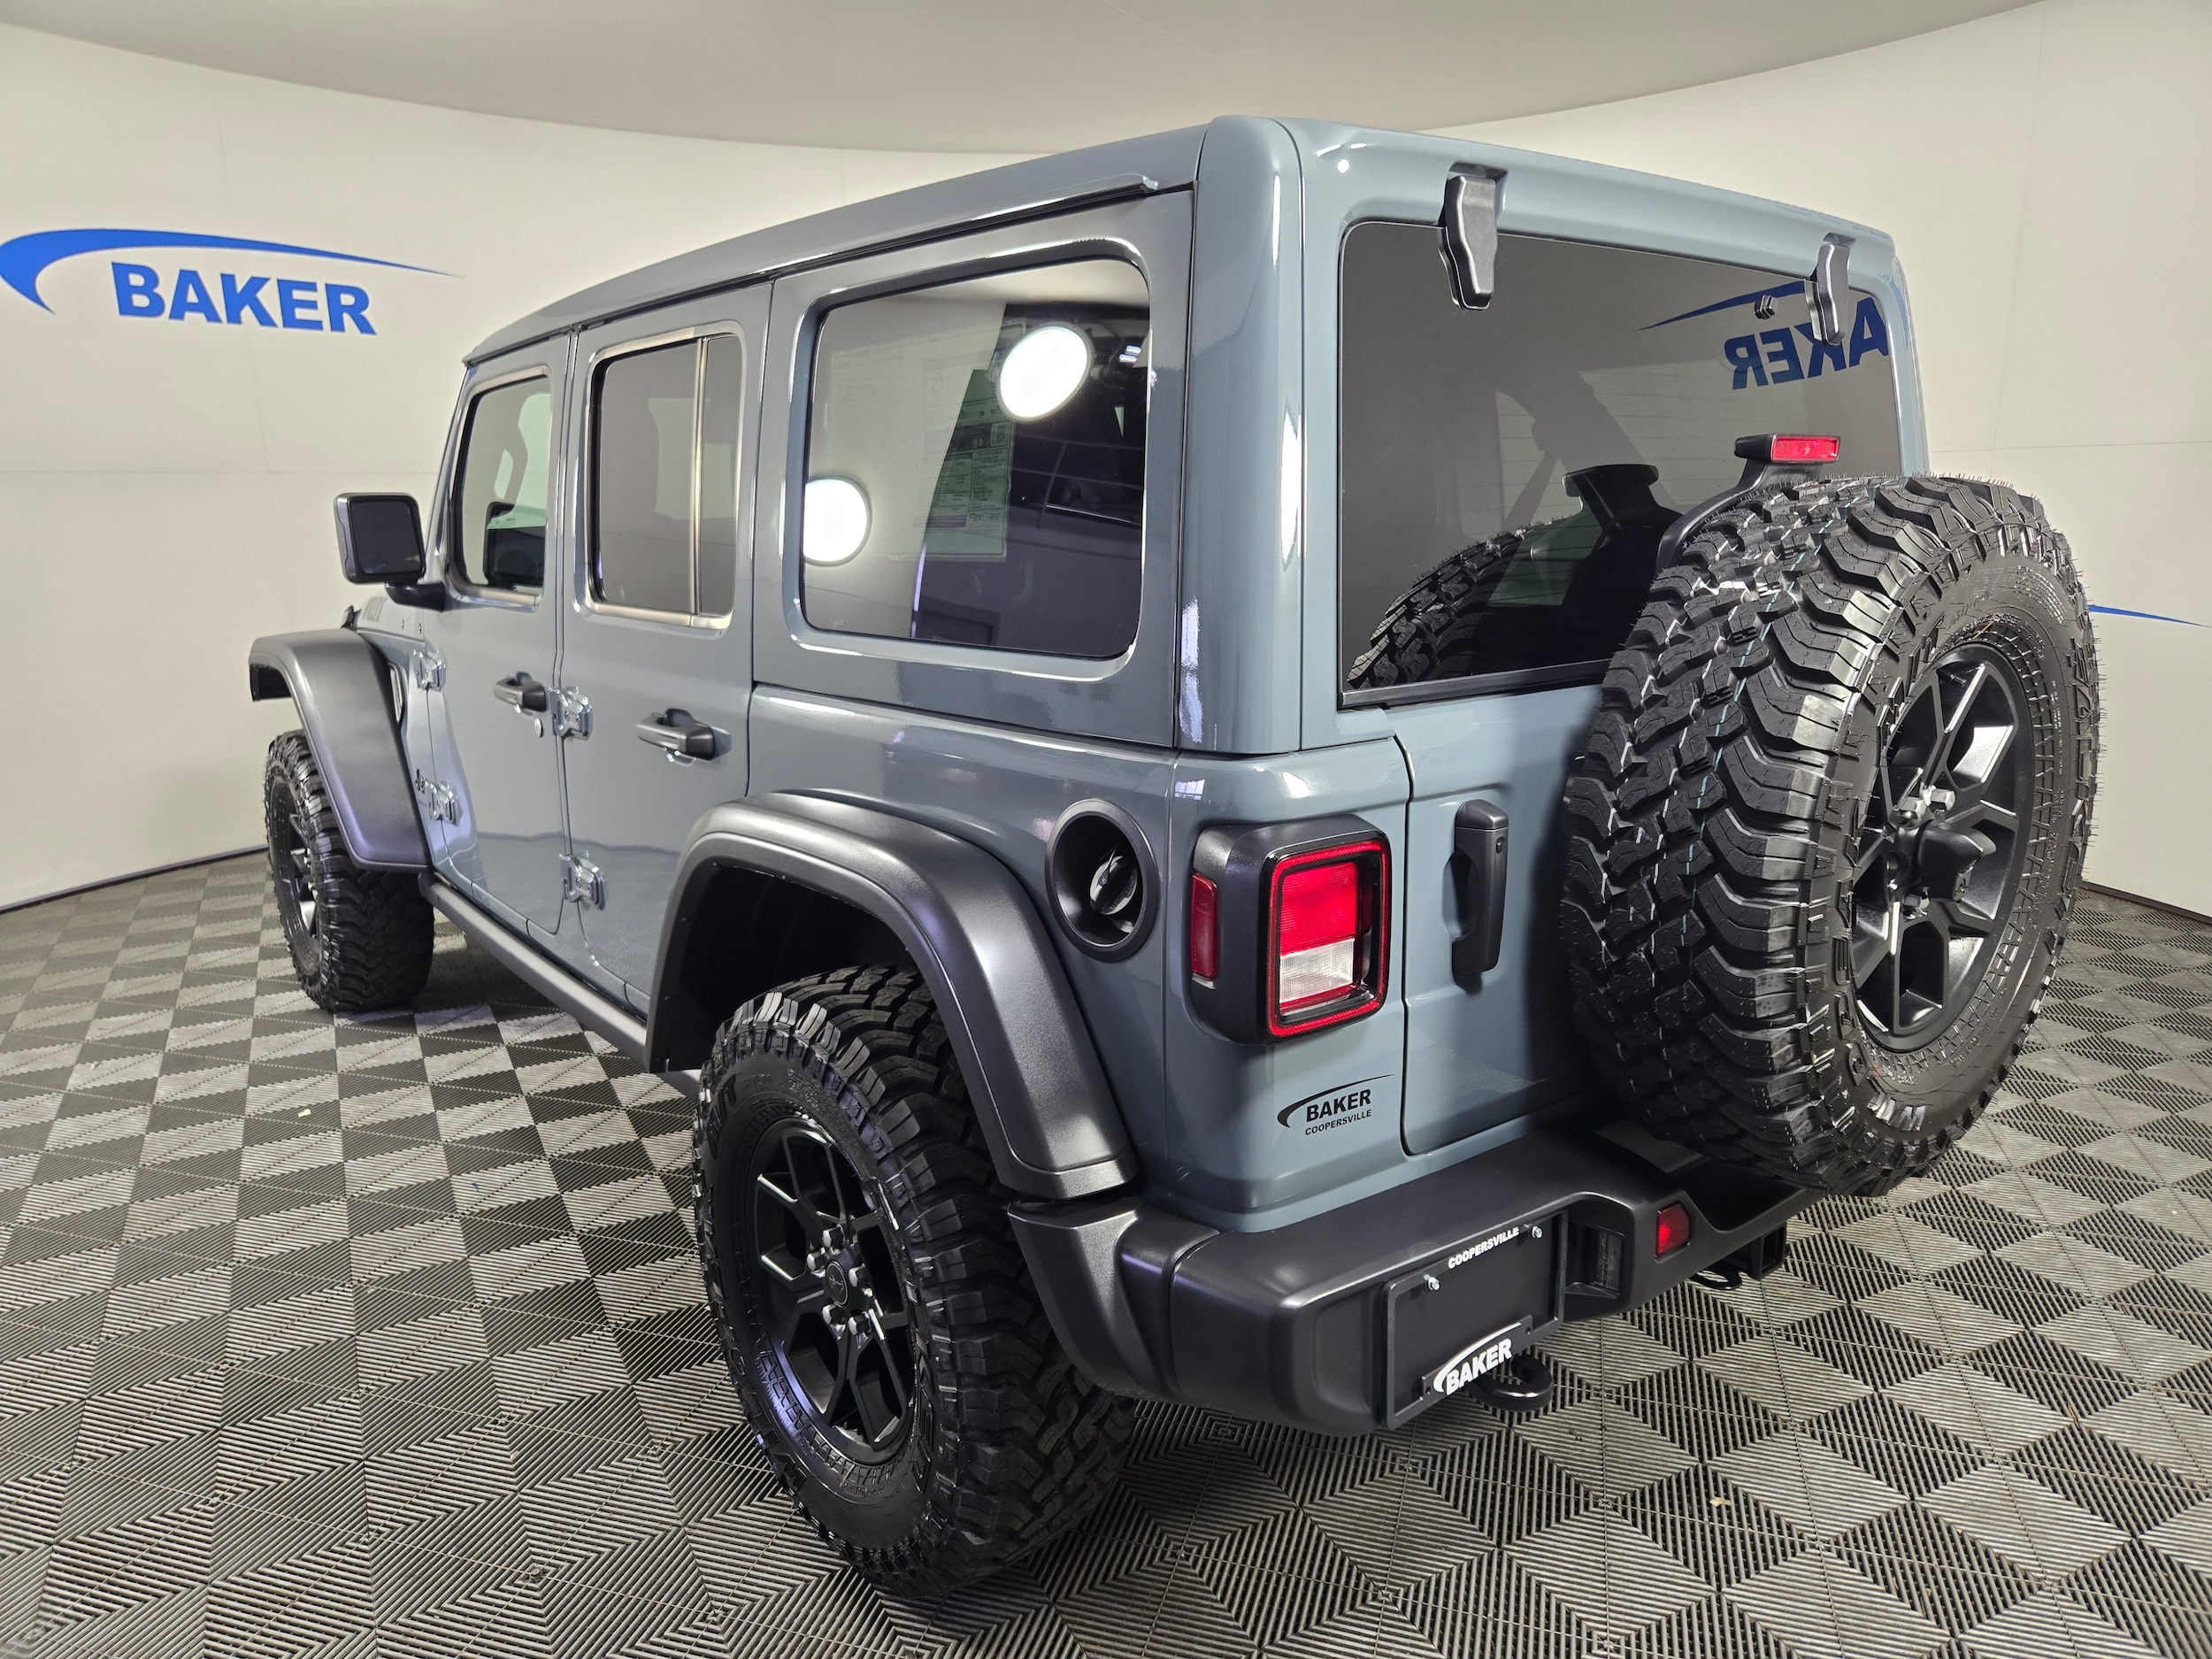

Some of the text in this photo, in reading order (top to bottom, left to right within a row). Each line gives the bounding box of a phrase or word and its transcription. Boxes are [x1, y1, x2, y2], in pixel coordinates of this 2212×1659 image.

[111, 261, 377, 335] BAKER
[1305, 1110, 1371, 1135] COOPERSVILLE
[1306, 1089, 1371, 1122] BAKER
[1448, 1226, 1519, 1269] COOPERSVILLE
[1446, 1338, 1512, 1395] BAKER
